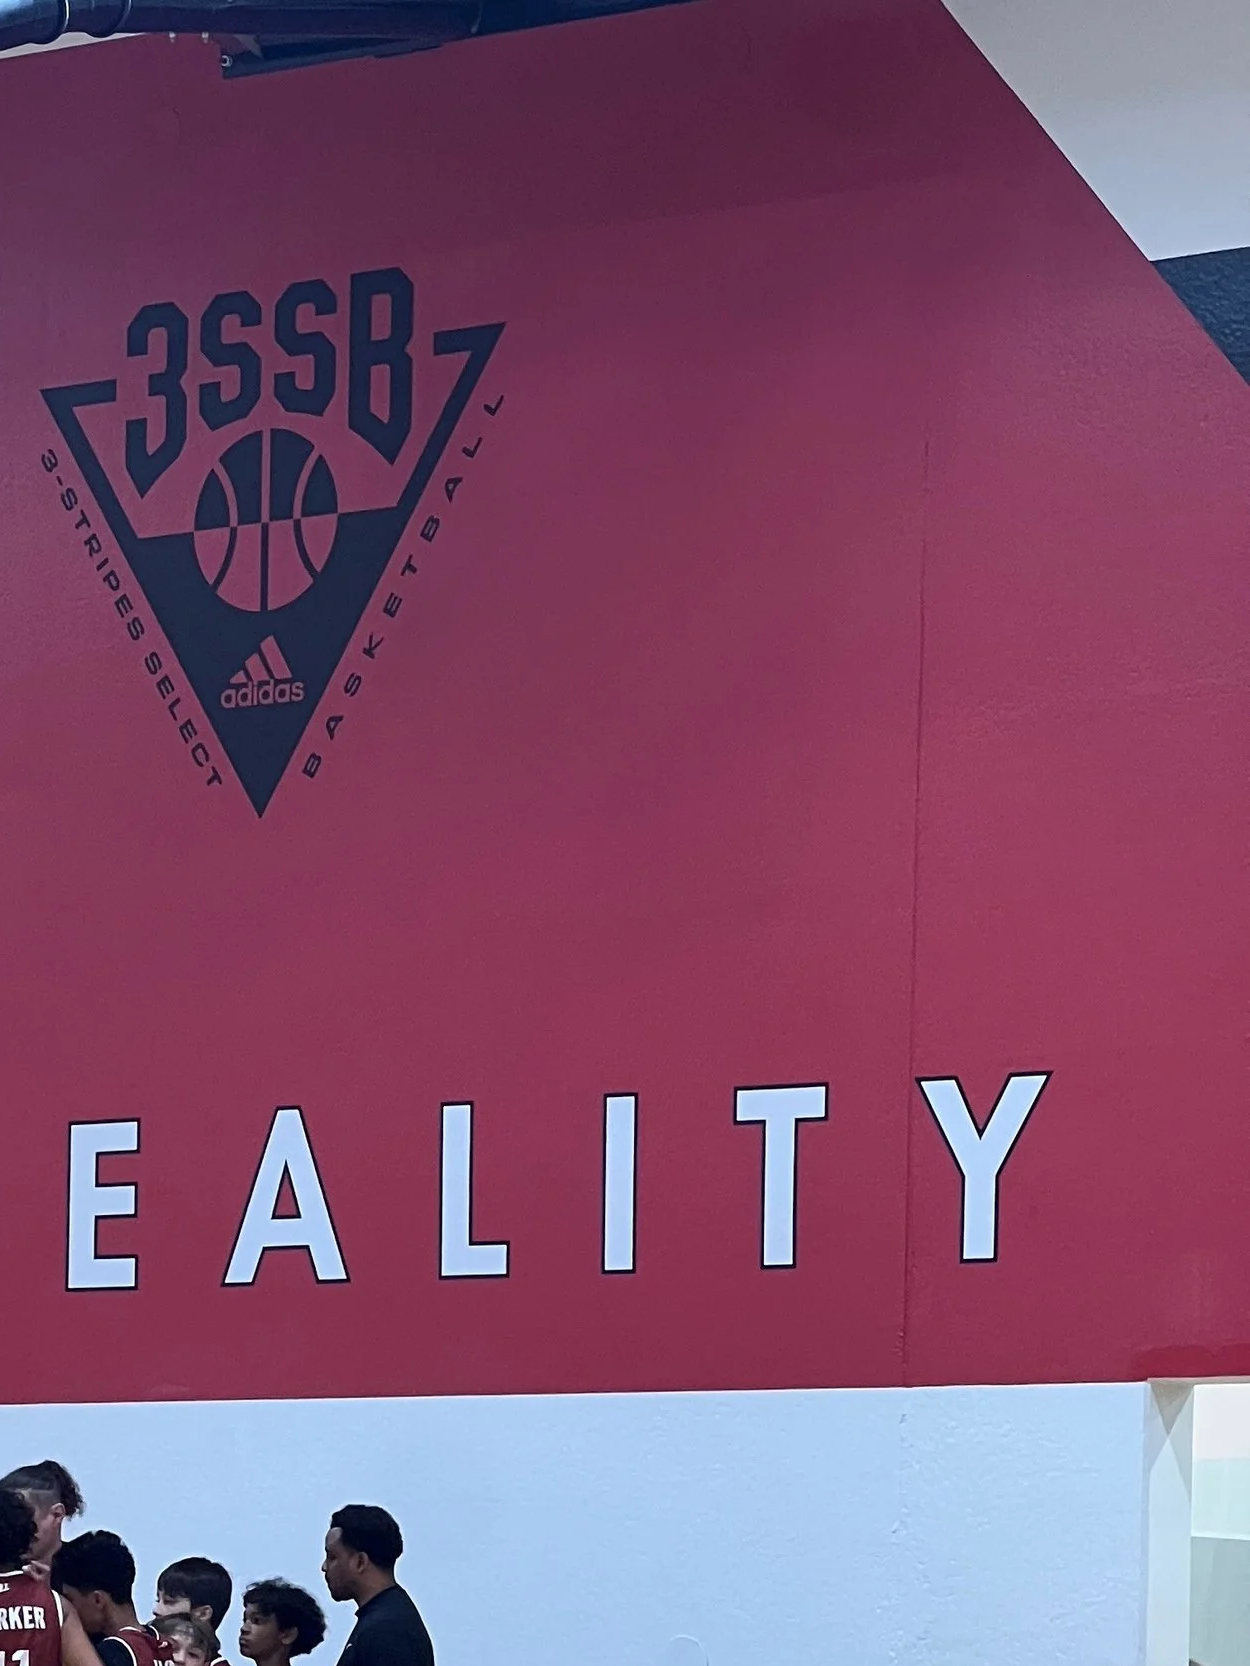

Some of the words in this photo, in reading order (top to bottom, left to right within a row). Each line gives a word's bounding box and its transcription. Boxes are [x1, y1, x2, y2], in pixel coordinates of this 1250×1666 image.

[125, 266, 415, 500] 3SSB
[40, 448, 145, 642] 3-STRIPES
[143, 650, 223, 788] SELECT
[220, 678, 305, 709] adidas
[301, 394, 504, 779] BASKETBALL
